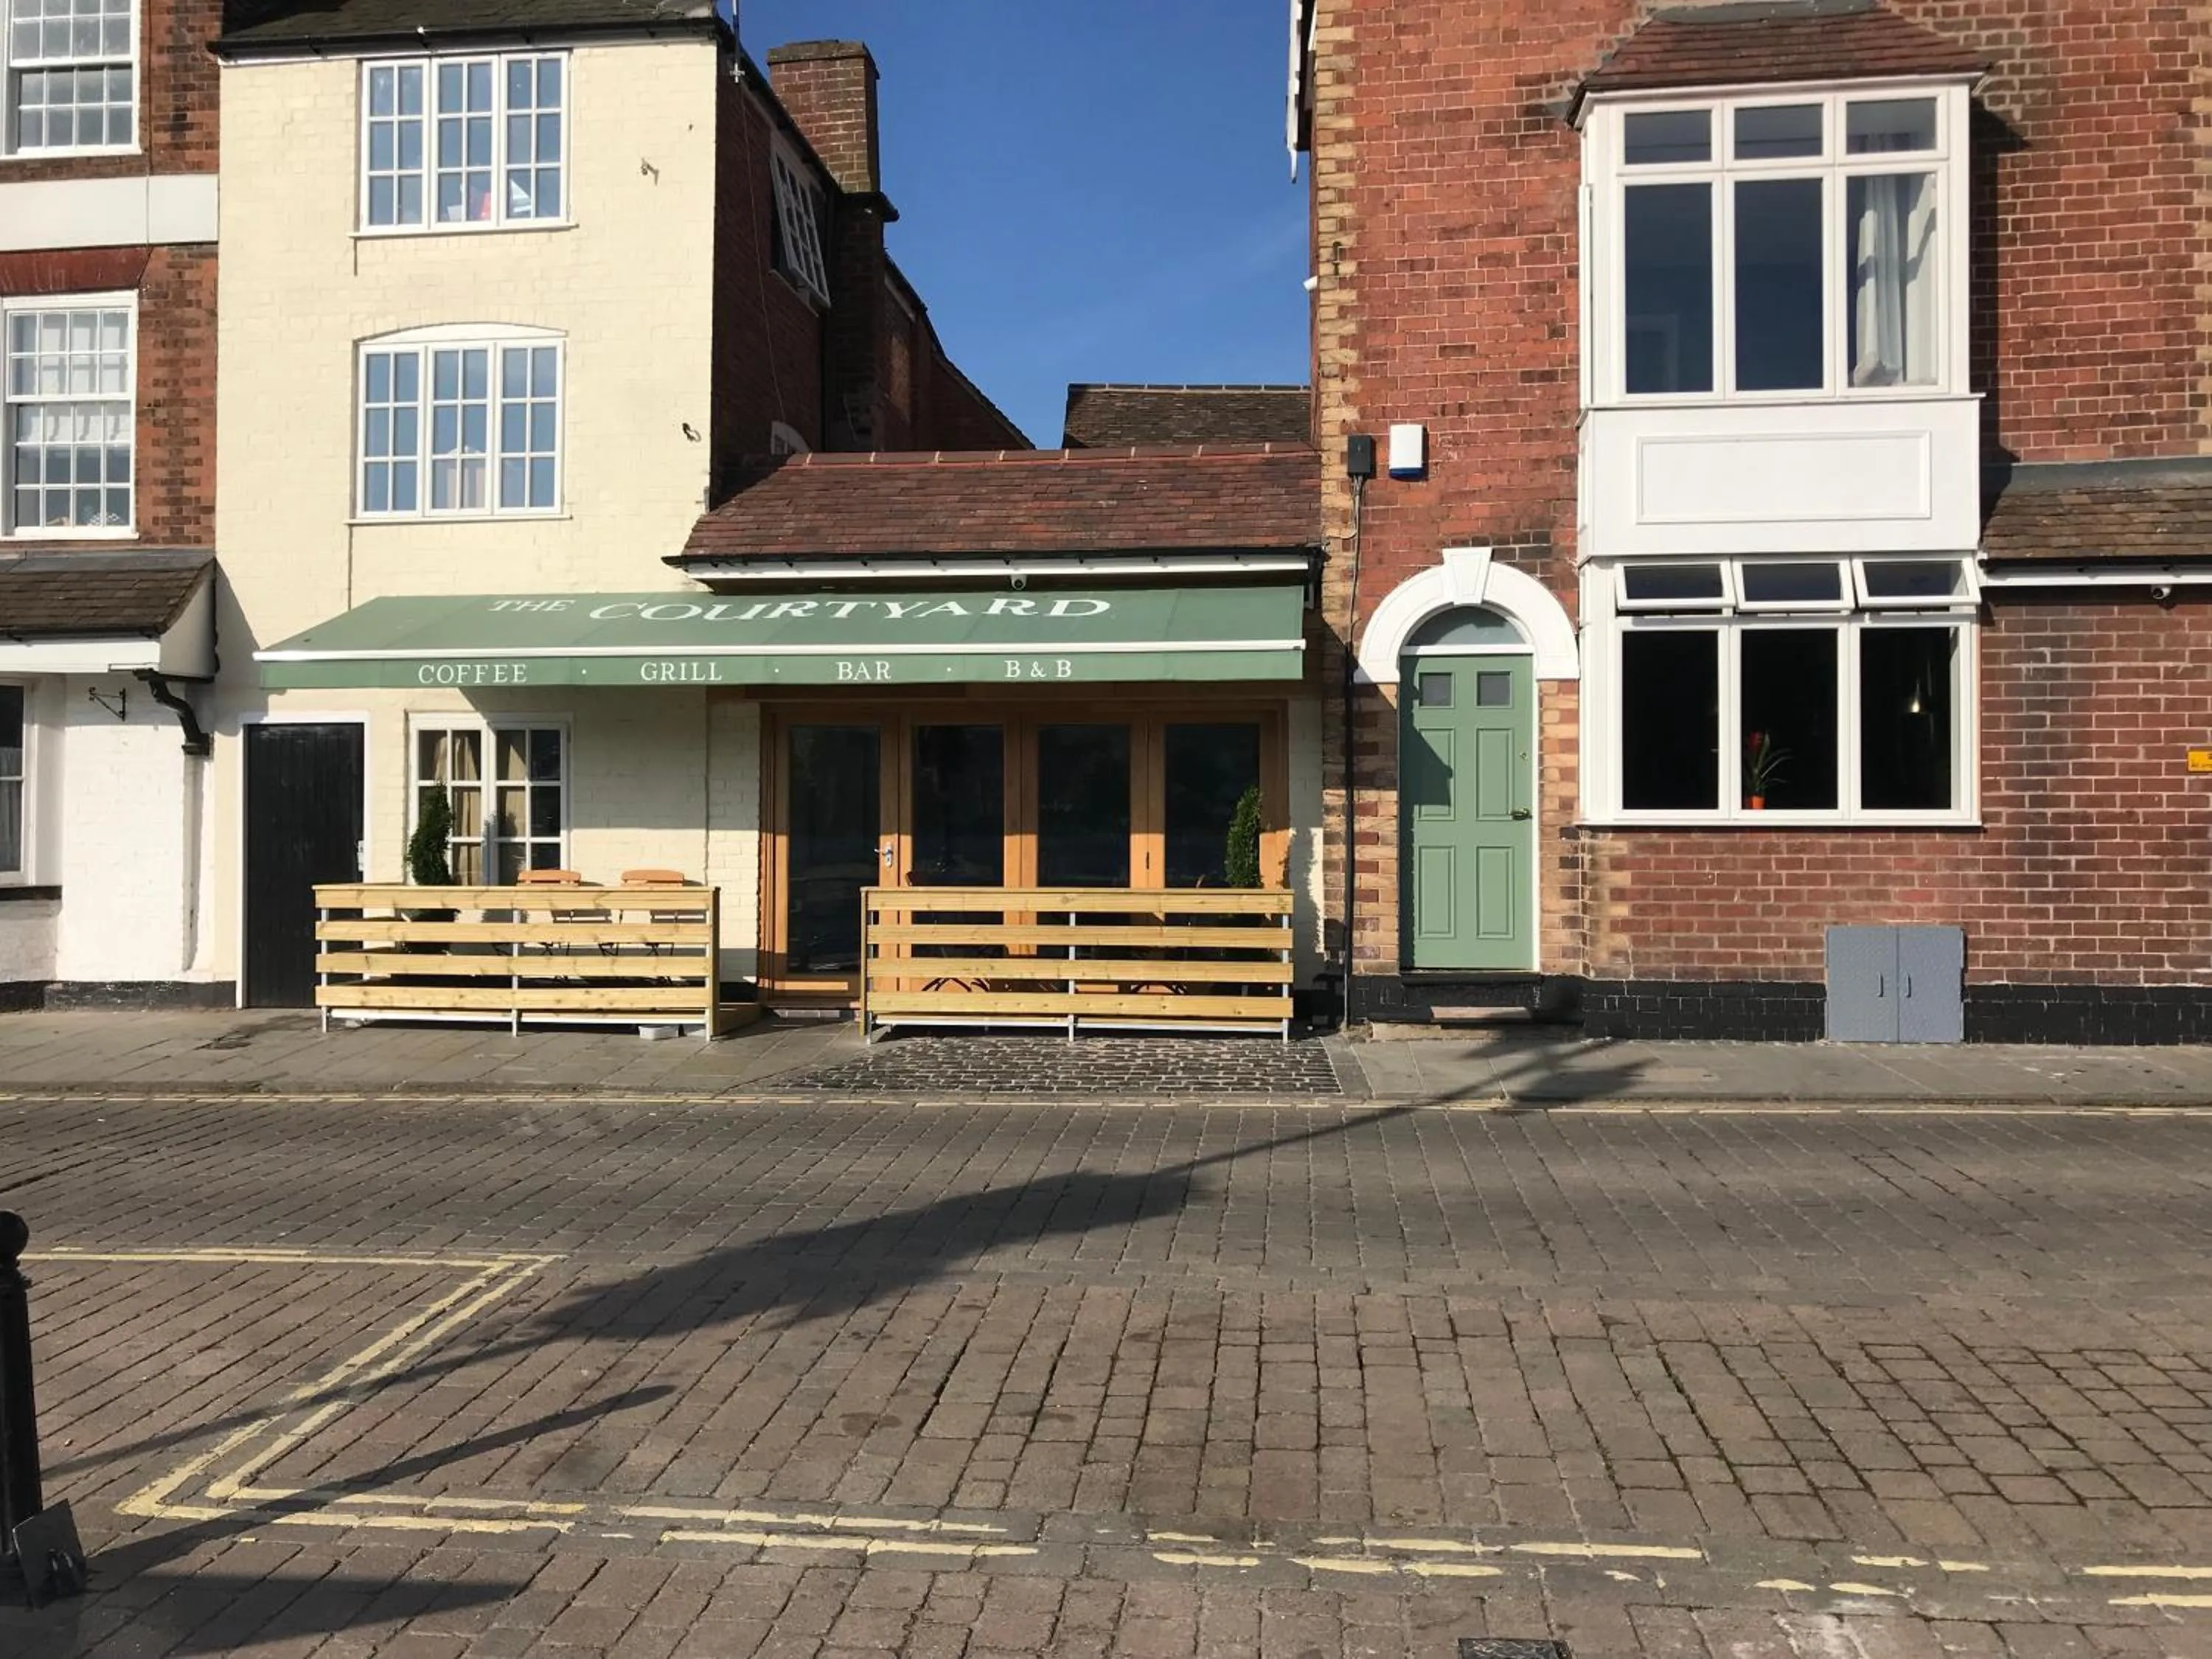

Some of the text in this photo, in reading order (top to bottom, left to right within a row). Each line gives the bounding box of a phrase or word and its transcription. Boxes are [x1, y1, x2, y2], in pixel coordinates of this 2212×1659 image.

[490, 598, 1110, 621] THE COURTYARD
[417, 663, 528, 684] COFFEE
[639, 661, 723, 682] GRILL
[836, 661, 891, 681] BAR
